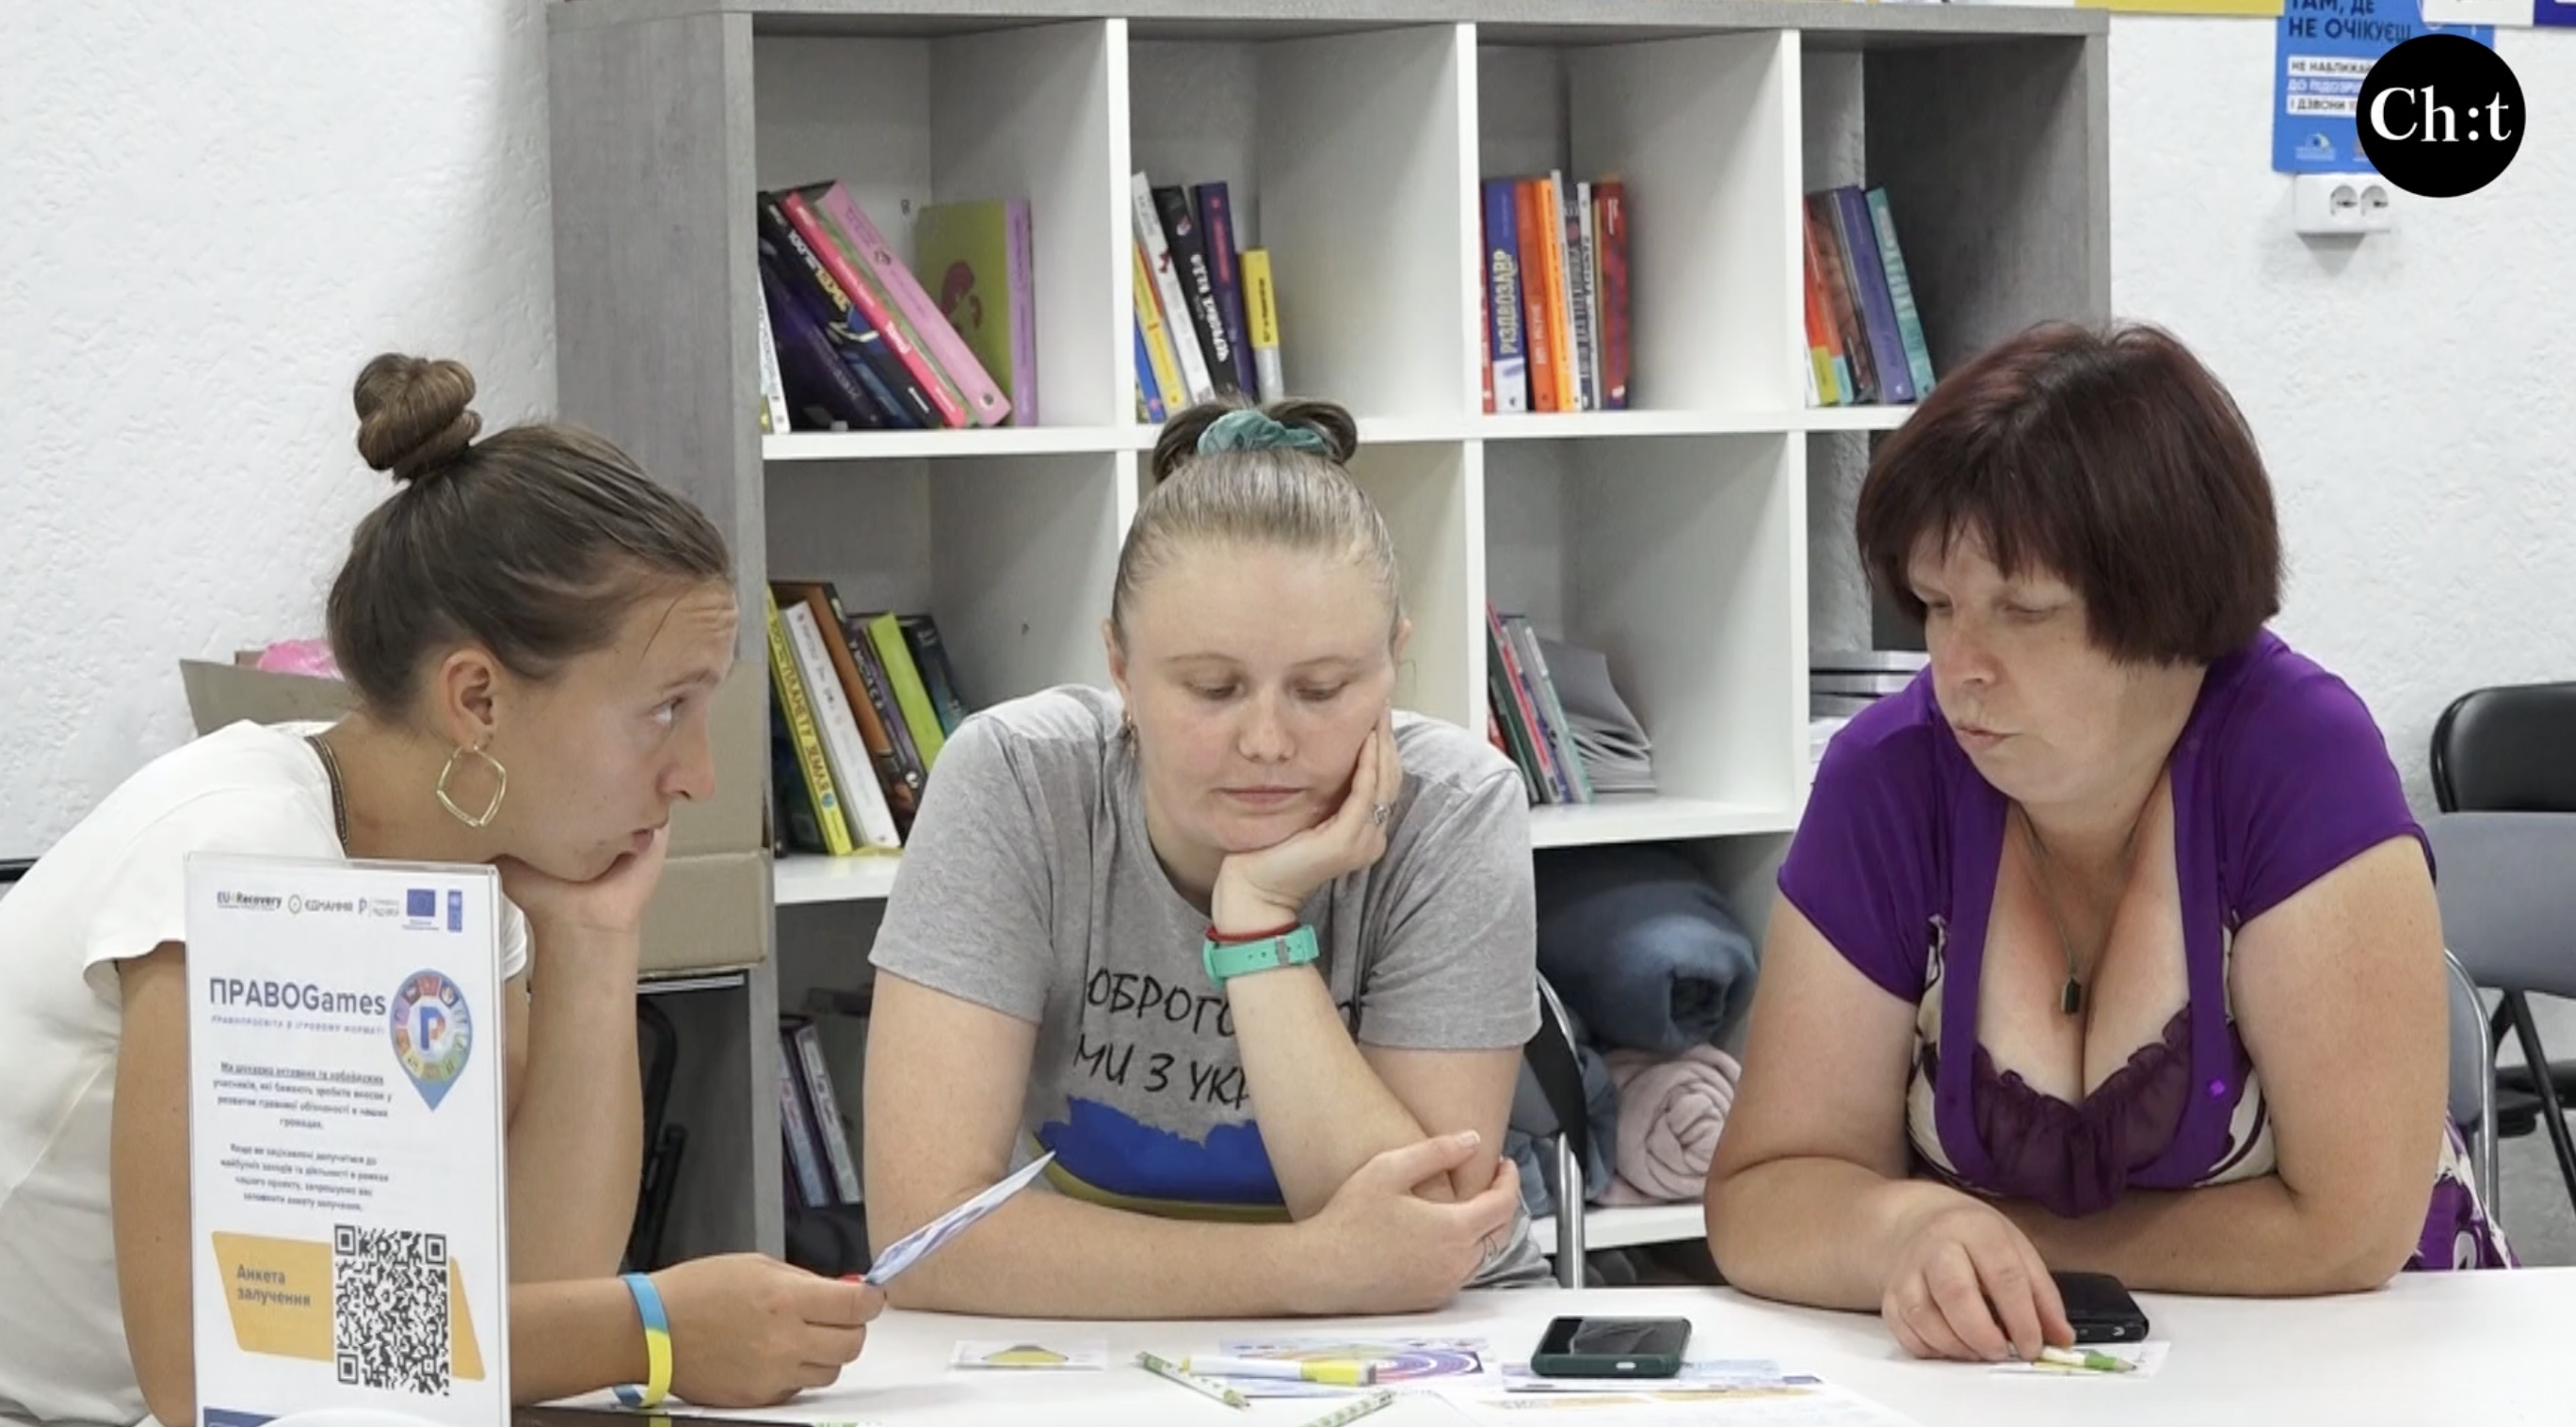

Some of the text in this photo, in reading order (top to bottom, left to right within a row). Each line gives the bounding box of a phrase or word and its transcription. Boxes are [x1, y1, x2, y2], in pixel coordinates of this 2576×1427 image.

[2288, 17, 2317, 38] НЕ
[2291, 61, 2306, 72] НЕ
[210, 977, 387, 1017] ПРАВОGames
[1073, 1034, 1134, 1085] МИ
[1144, 1053, 1175, 1093] З
[237, 1265, 285, 1285] Анкета
[236, 1287, 311, 1307] залучення
